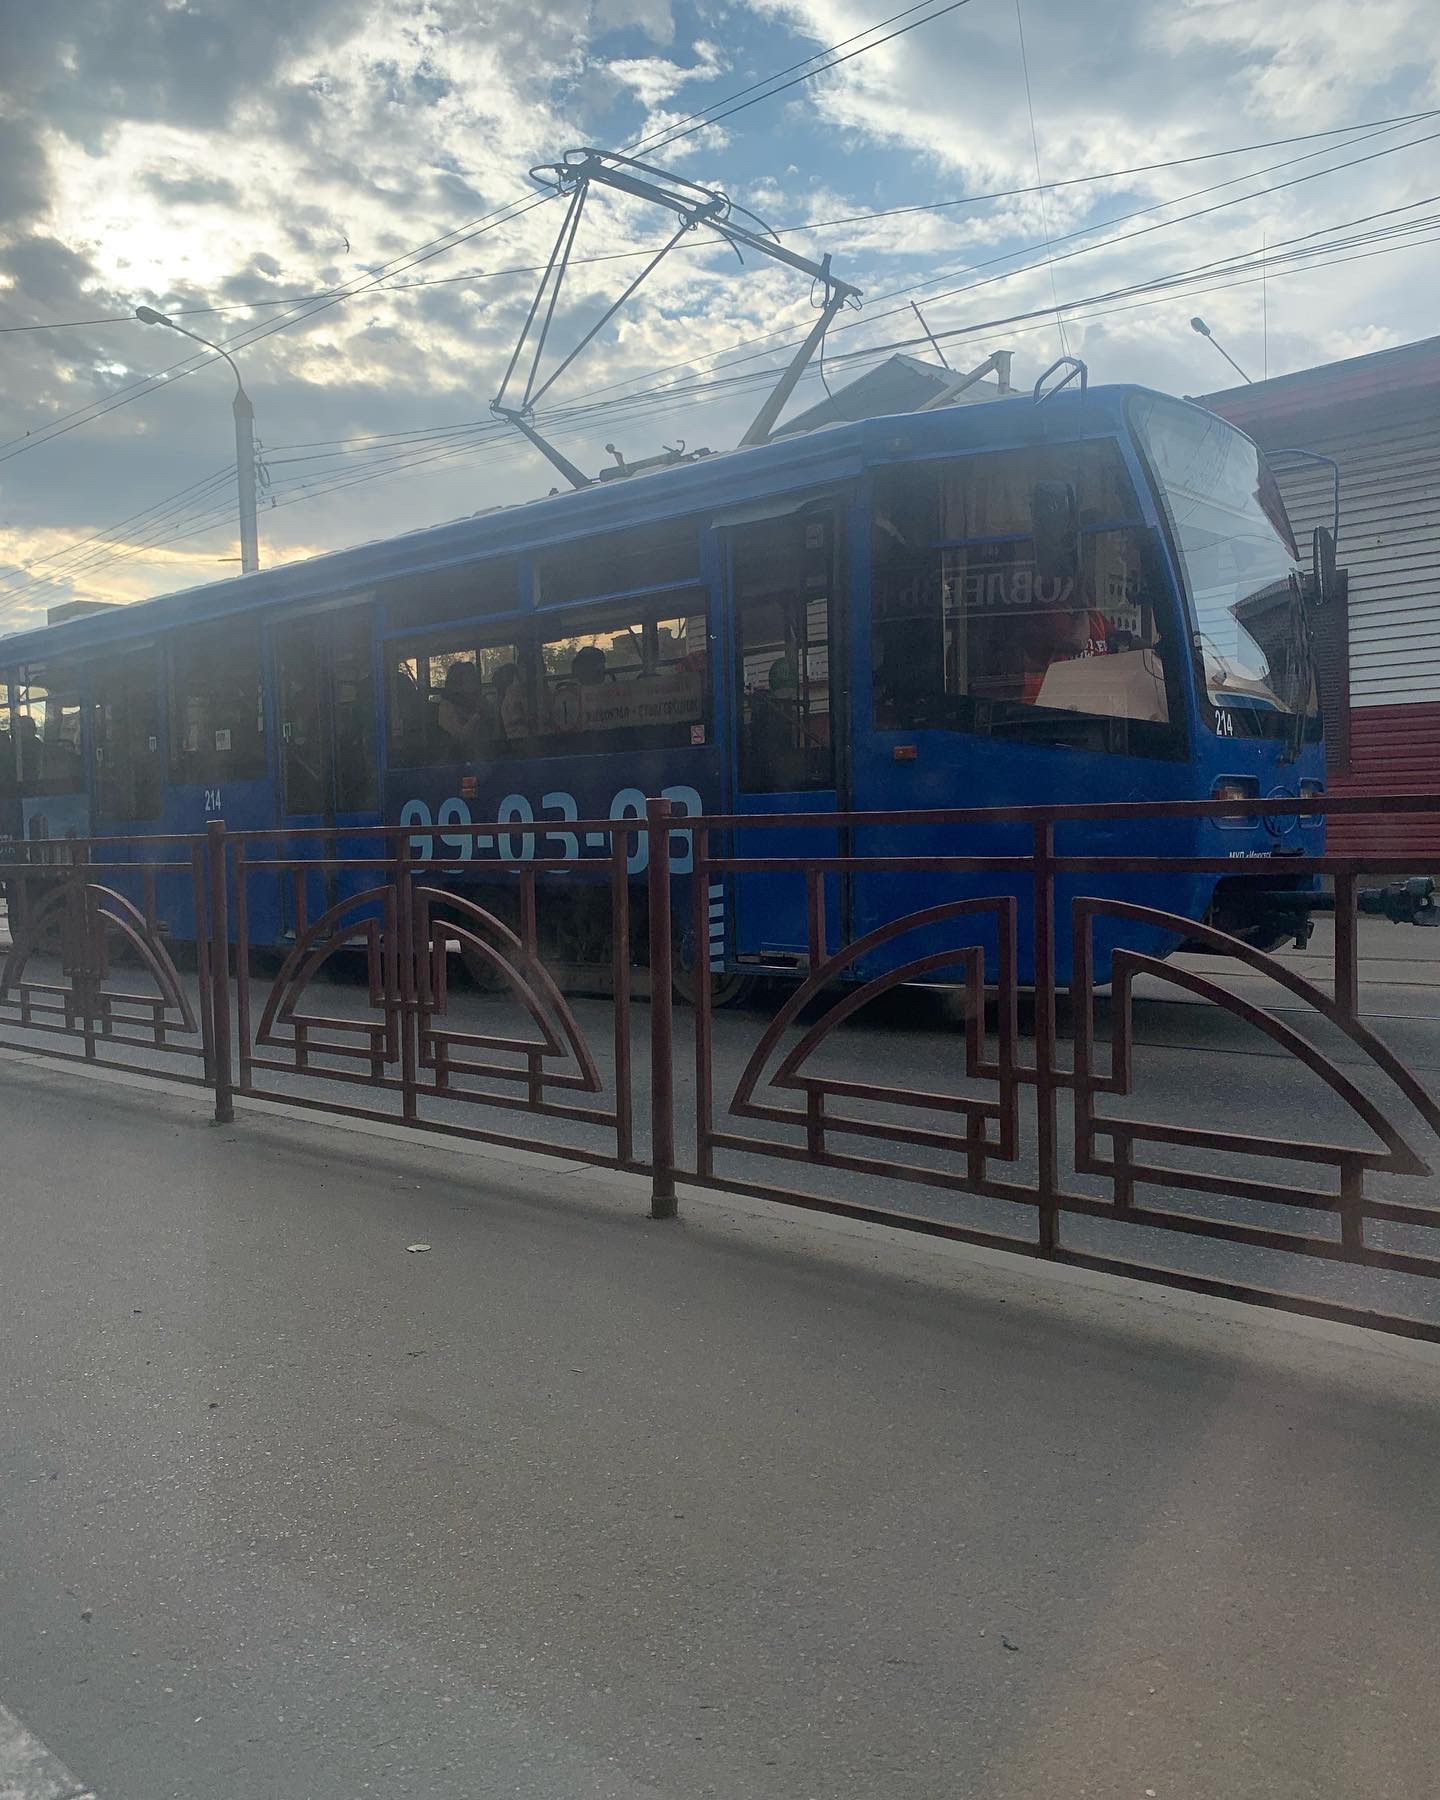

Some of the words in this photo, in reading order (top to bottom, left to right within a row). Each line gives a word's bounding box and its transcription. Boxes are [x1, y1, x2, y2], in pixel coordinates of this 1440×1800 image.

[1214, 709, 1234, 737] 214
[204, 788, 222, 812] 214
[400, 785, 703, 875] 99-03-03
